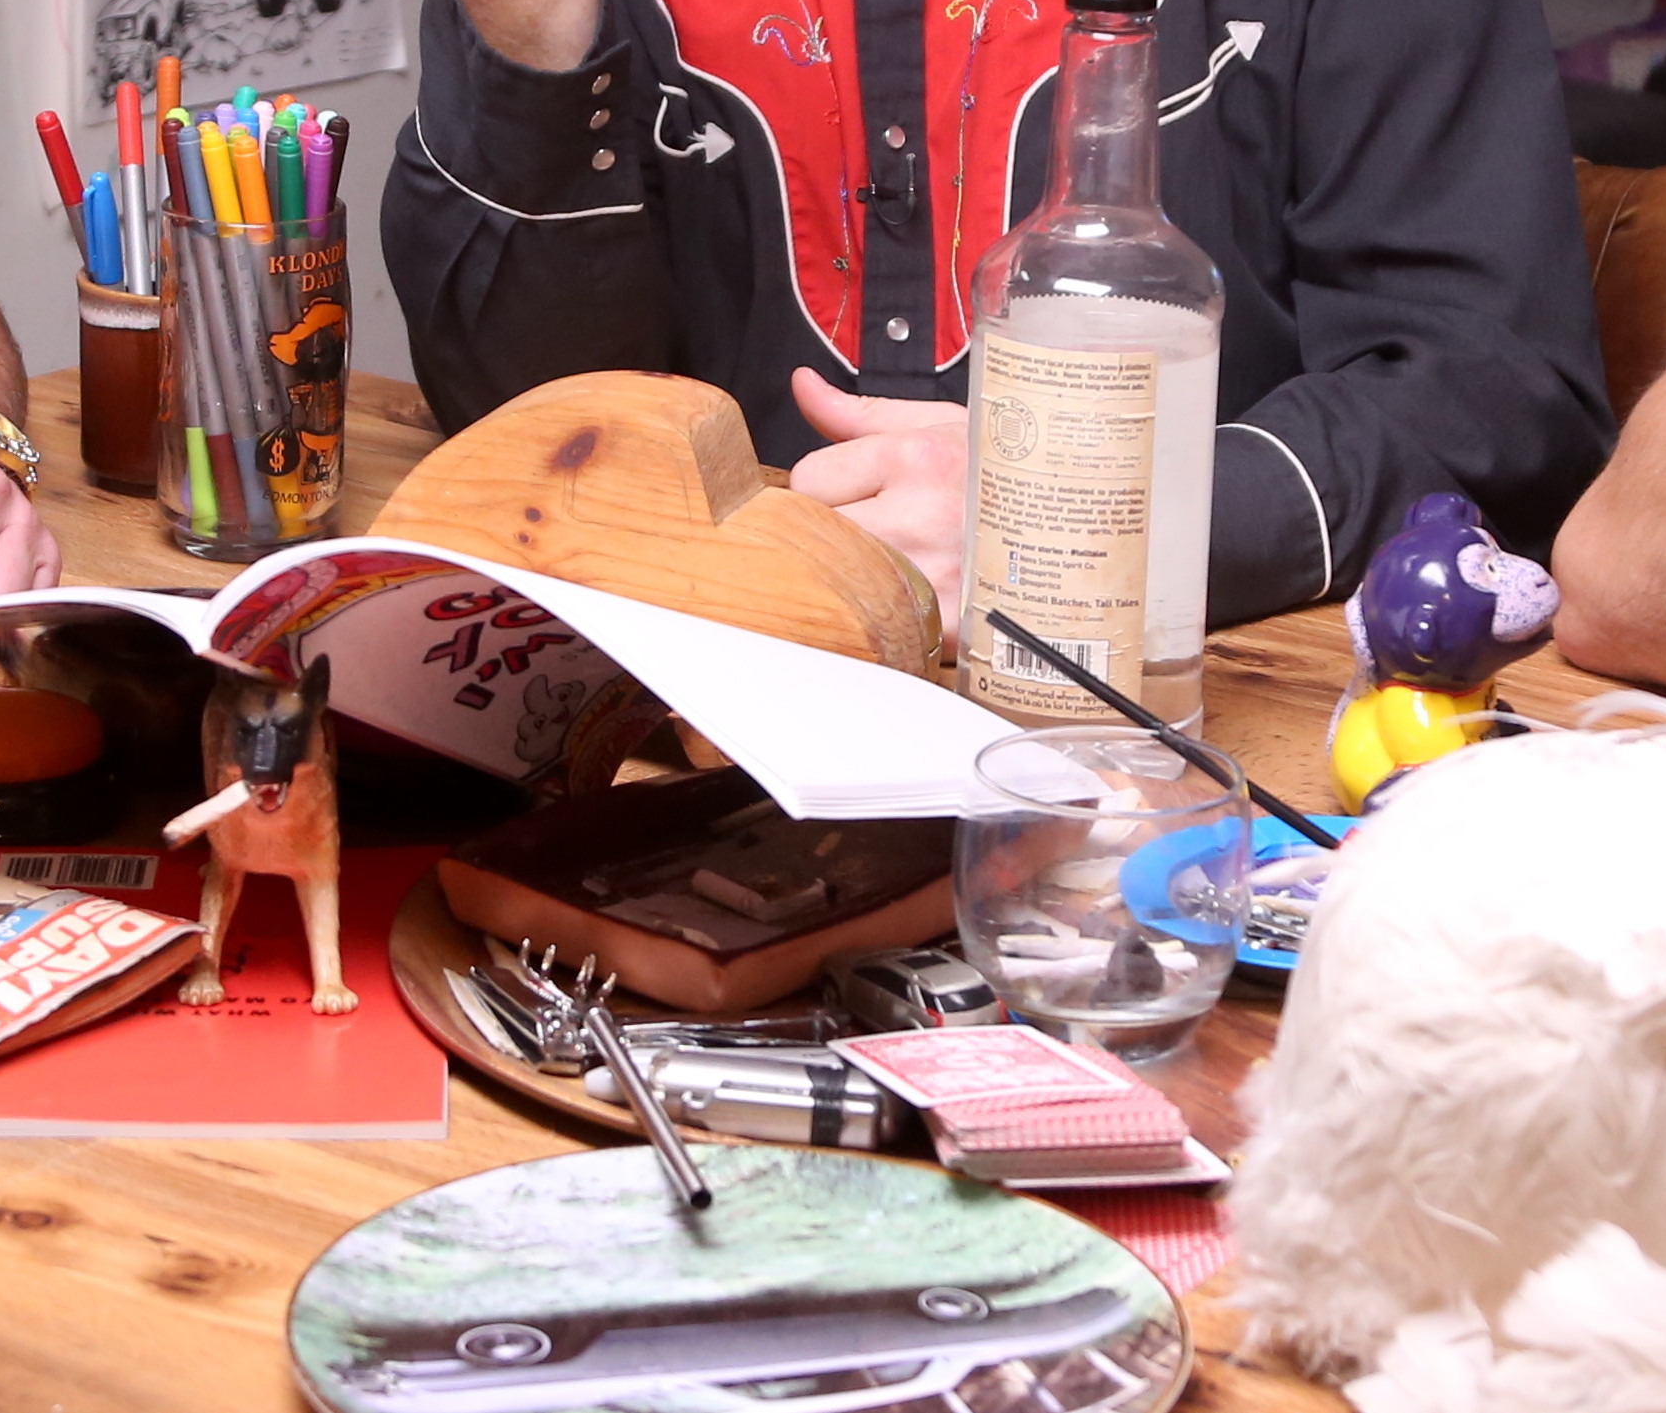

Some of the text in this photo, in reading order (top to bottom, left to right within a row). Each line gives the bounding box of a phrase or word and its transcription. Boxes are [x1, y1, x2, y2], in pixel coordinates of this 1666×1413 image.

[301, 269, 344, 293] DAYS
[1001, 536, 1019, 548] Share
[1020, 543, 1036, 551] your
[1037, 545, 1063, 555] stories
[1019, 554, 1097, 570] Nova Scotia Spirit Co.
[977, 576, 1139, 610] Small Town, Small Batches, Tall Tales
[991, 678, 1013, 694] Return
[1015, 683, 1025, 698] for
[1026, 687, 1054, 702] refund
[1055, 690, 1081, 704] where
